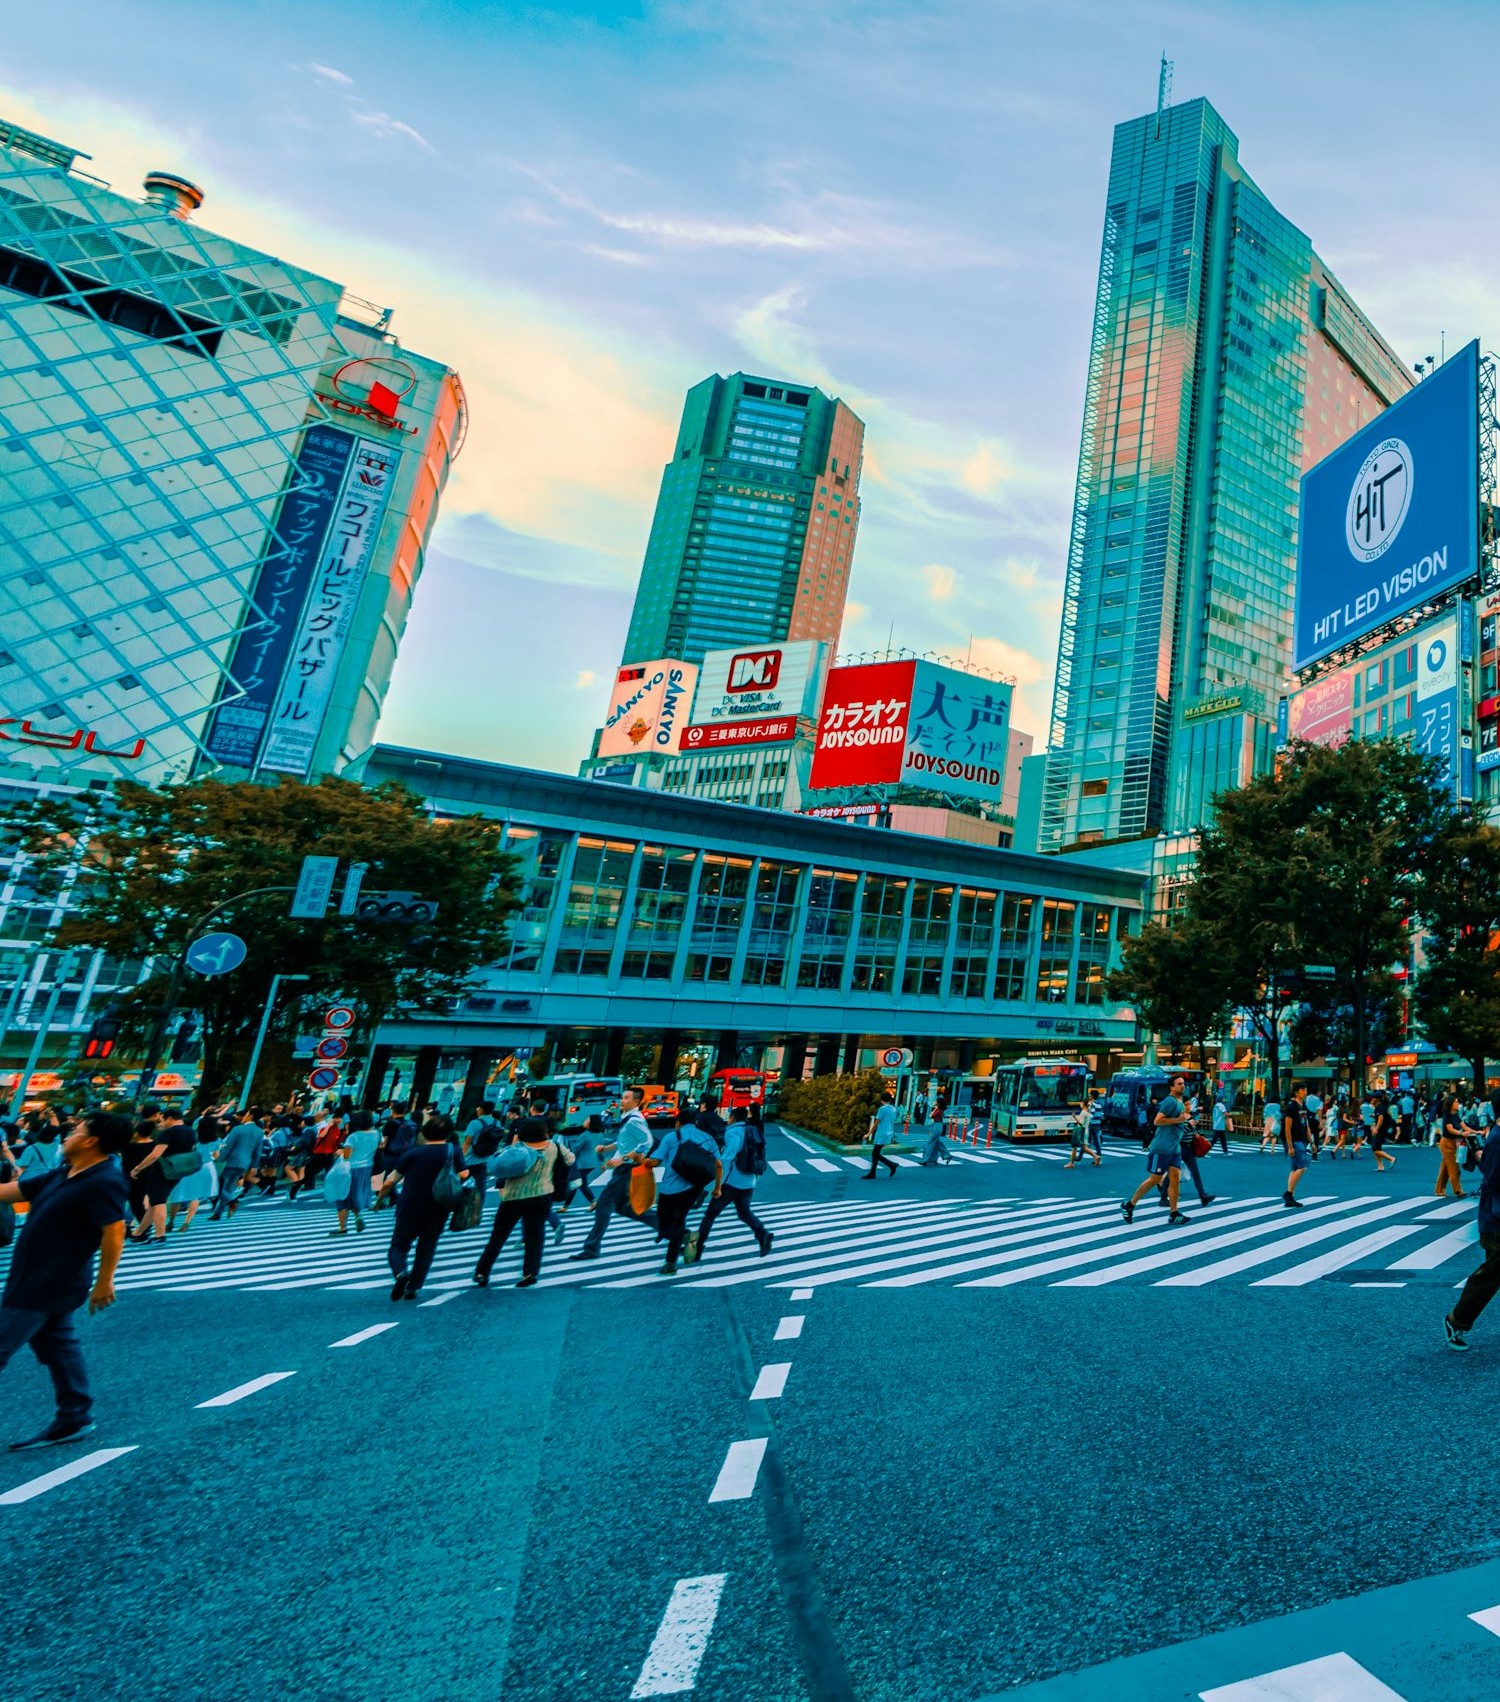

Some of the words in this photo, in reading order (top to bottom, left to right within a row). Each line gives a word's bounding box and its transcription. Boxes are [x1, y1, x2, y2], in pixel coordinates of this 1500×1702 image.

[281, 500, 368, 720] ワコールビッグバザール
[1313, 609, 1342, 645] HIT
[1344, 586, 1380, 627] LED
[1382, 546, 1448, 611] VISION
[1483, 624, 1495, 639] 9F
[731, 654, 776, 687] DC
[606, 672, 664, 728] SANKYO
[656, 669, 686, 745] SANKYO
[712, 706, 728, 717] DC
[728, 700, 782, 715] MasterCard
[722, 695, 737, 705] DC
[740, 692, 762, 703] VISA
[823, 698, 907, 730] カラオケ
[915, 681, 1009, 731] 大声
[709, 722, 788, 741] 三菱東京UFJ銀行
[819, 726, 905, 750] JOYSOUND
[908, 723, 1001, 765] だそうぜ
[1483, 726, 1497, 746] 7F
[905, 751, 1000, 787] JOYSOUND
[813, 807, 841, 817] カラオケ
